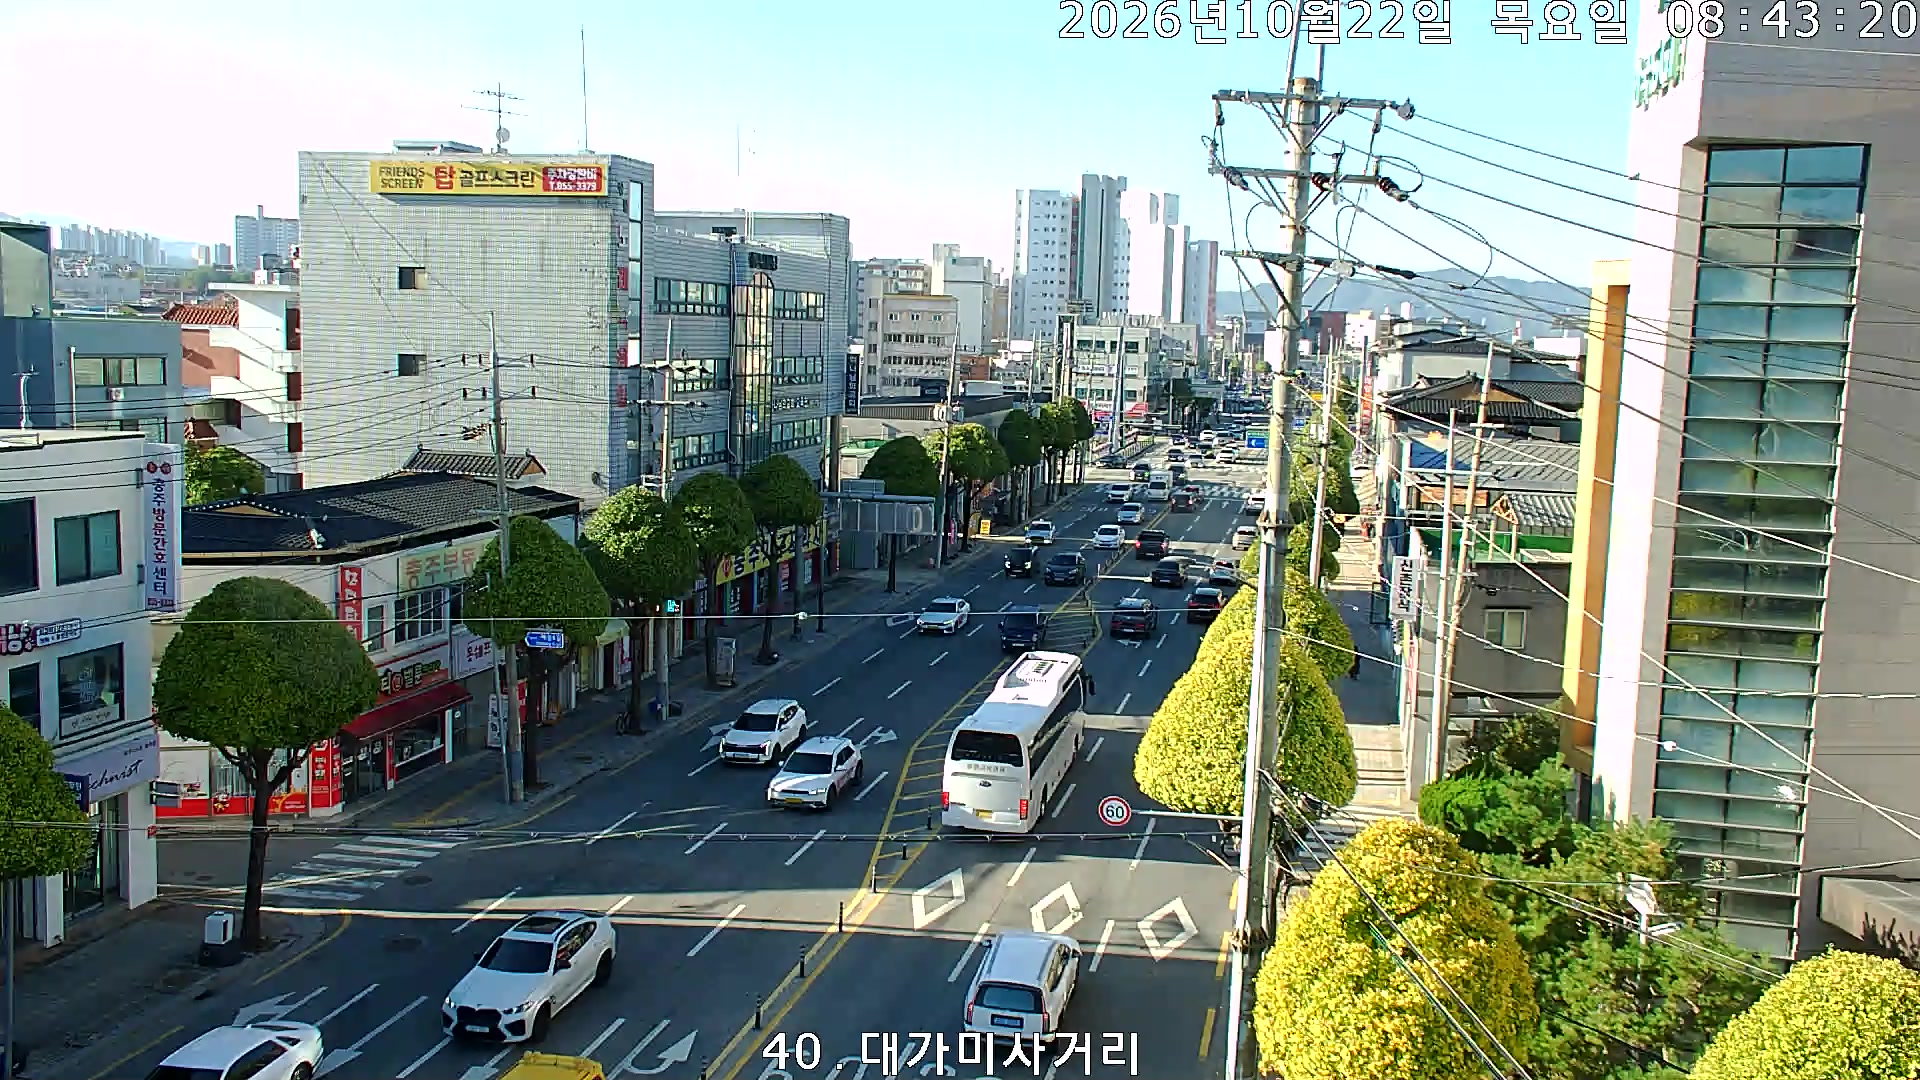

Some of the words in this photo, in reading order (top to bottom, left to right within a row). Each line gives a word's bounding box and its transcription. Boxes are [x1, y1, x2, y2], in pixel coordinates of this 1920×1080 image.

[379, 167, 425, 178] FRIENDS
[435, 166, 456, 189] 탑
[459, 169, 535, 188] 골프스크린
[380, 178, 424, 189] SCREEN
[1105, 804, 1125, 819] 60
